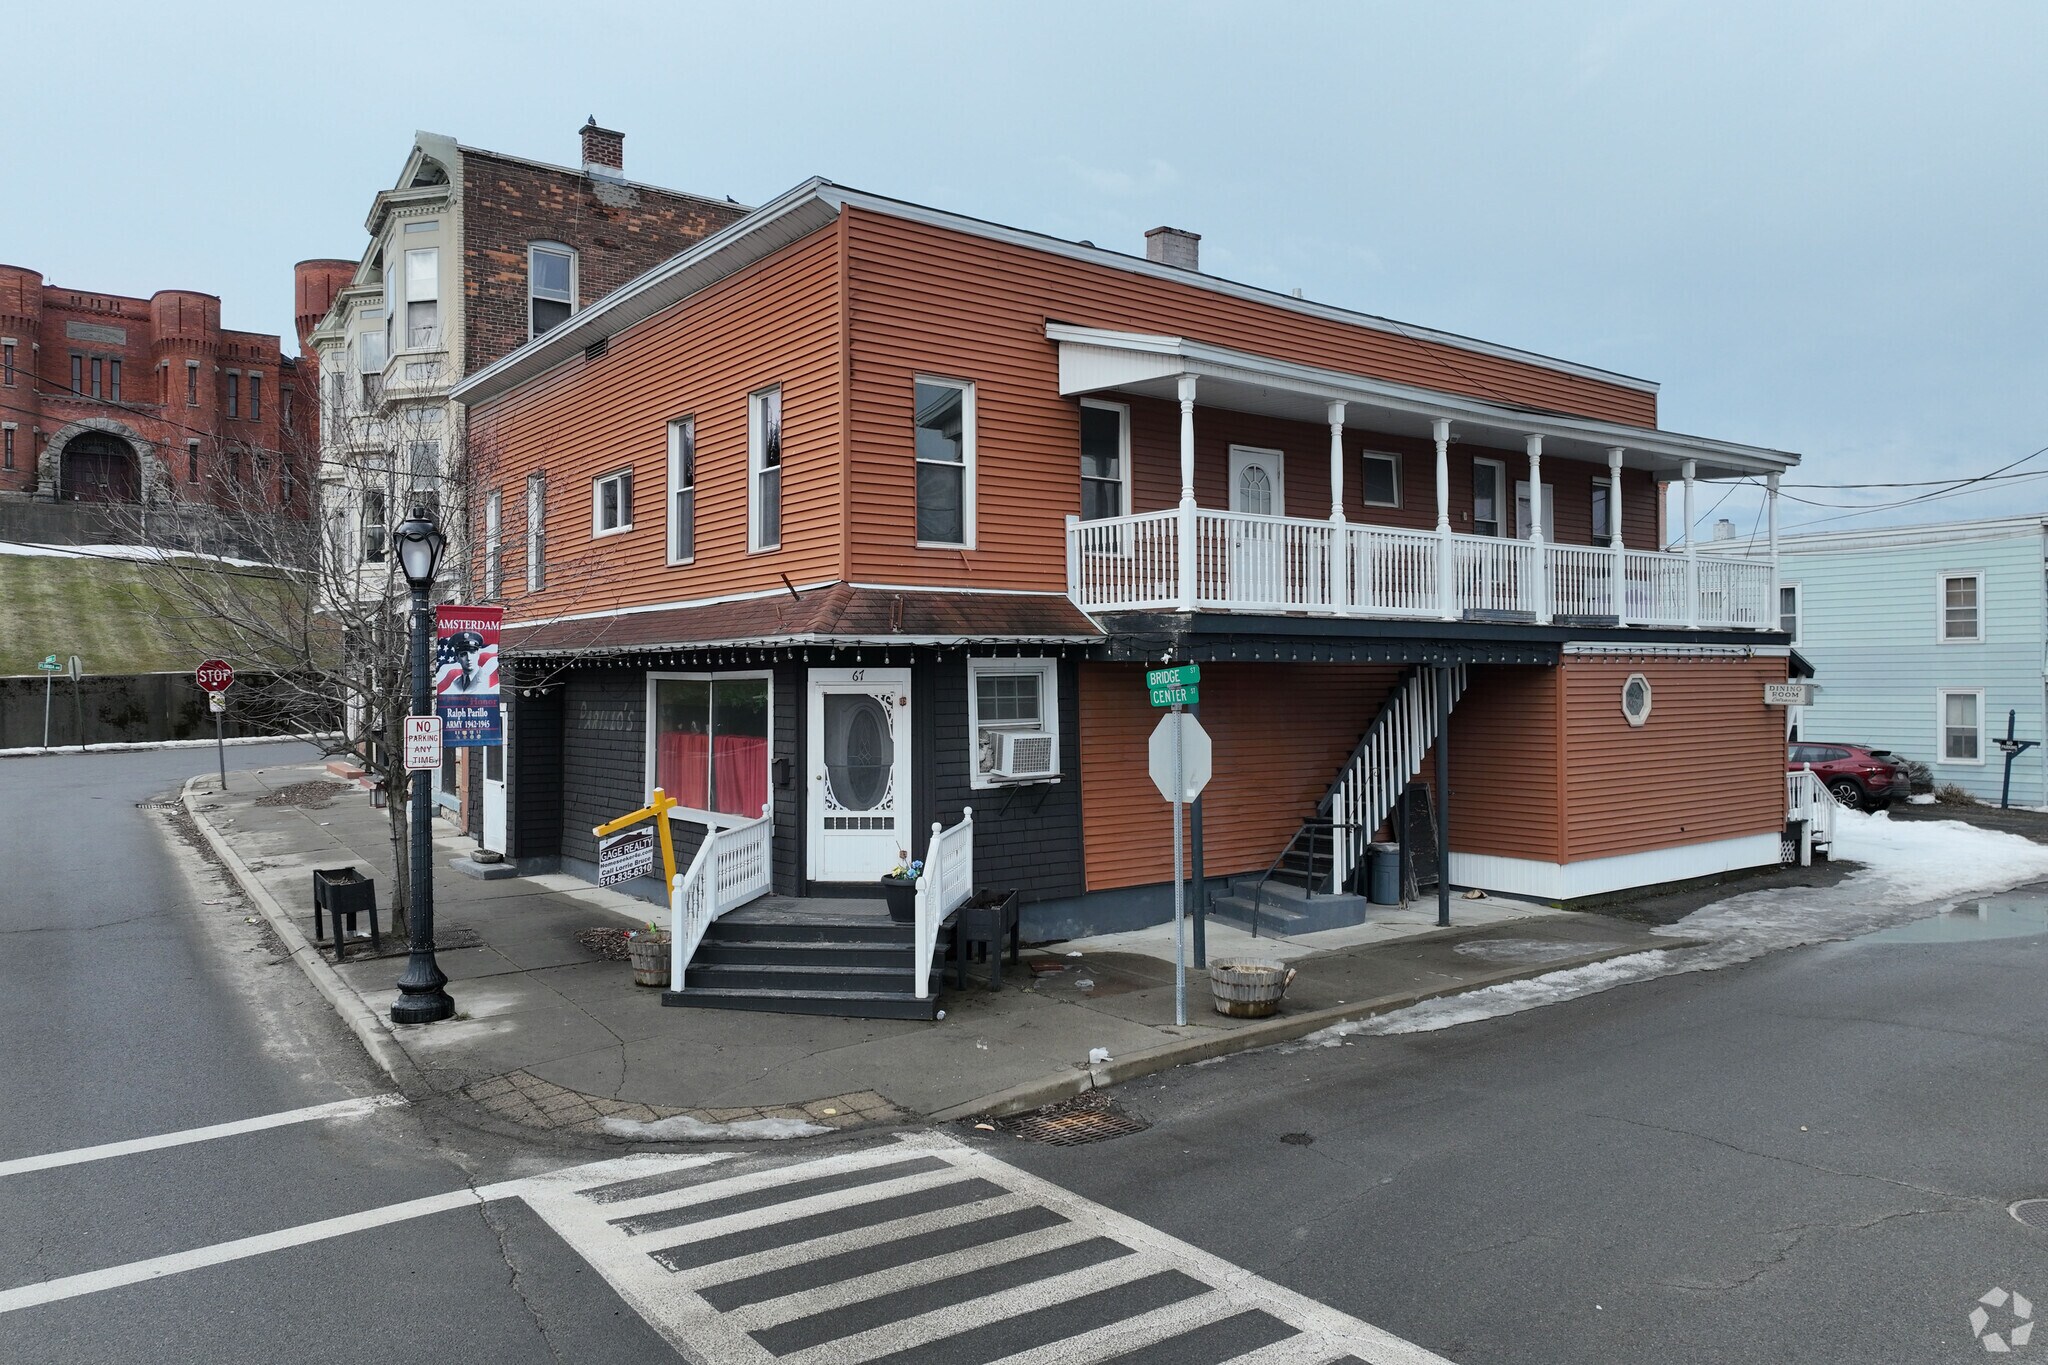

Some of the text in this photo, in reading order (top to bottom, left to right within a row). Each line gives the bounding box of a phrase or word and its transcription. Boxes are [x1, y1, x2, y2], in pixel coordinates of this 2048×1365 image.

[438, 619, 500, 630] AMSTERDAM
[199, 669, 231, 682] STOP
[852, 669, 865, 682] 67
[1150, 666, 1196, 685] BRIDGE ST
[470, 697, 497, 706] Honor
[1153, 687, 1196, 704] CENTER ST
[446, 707, 488, 720] Ralph Parillo
[416, 721, 431, 733] NO
[446, 720, 490, 729] ARMY 1942-1945
[408, 734, 439, 742] PARKING
[414, 745, 432, 753] ANY
[412, 756, 434, 764] TIME
[601, 838, 653, 861] GAGE REALTY
[601, 856, 652, 876] Call Lorrie Bruce
[600, 864, 652, 886] 518-835-6310
